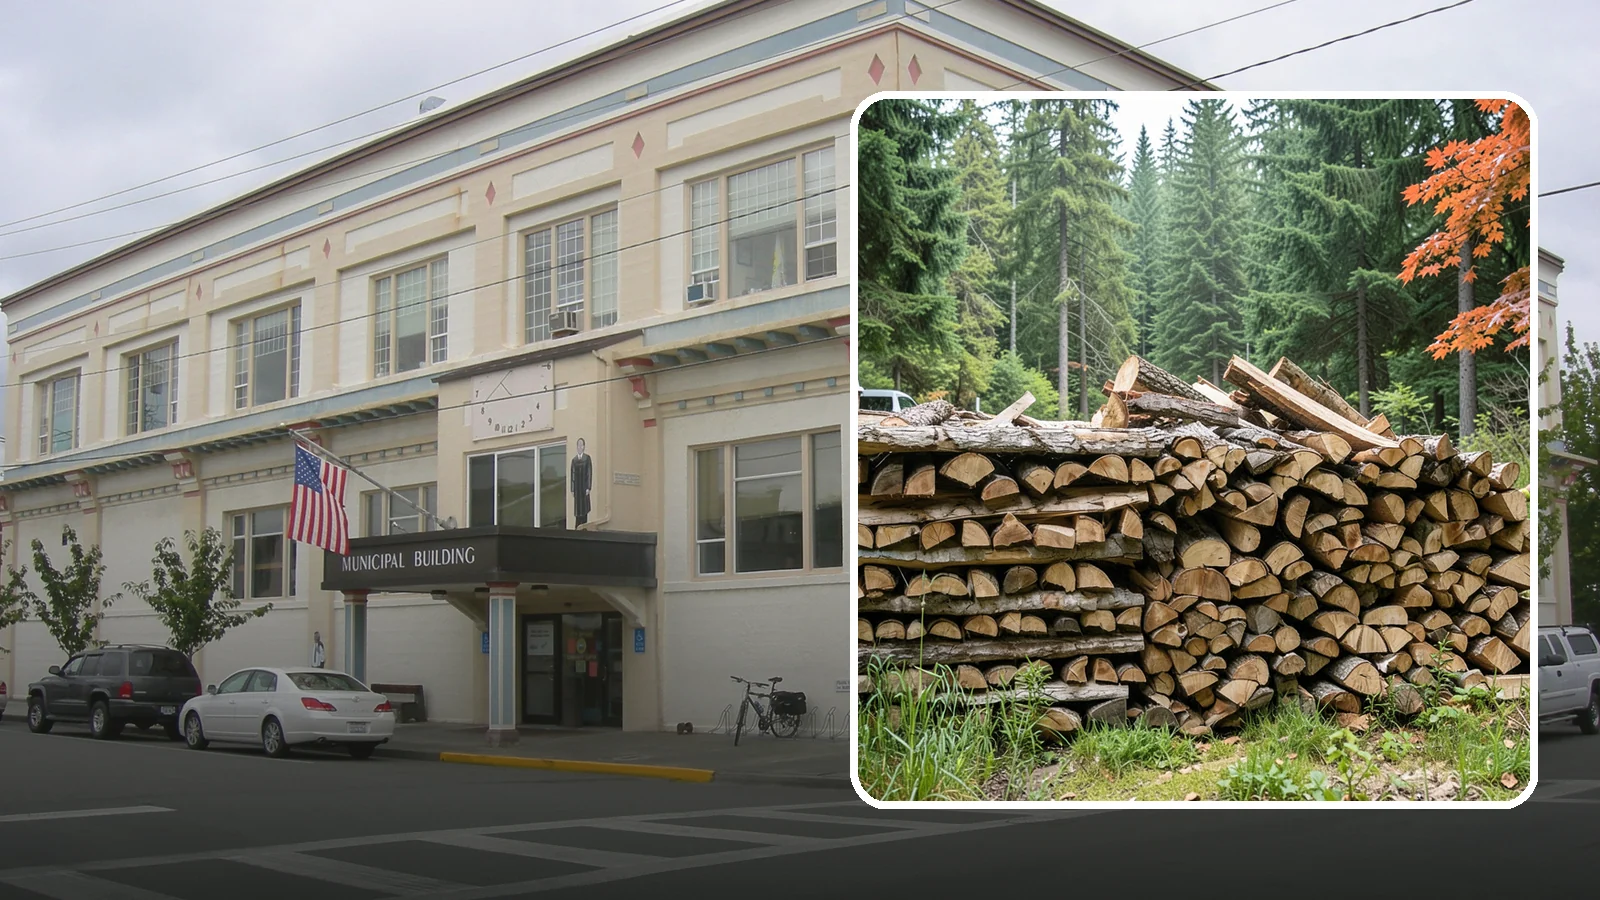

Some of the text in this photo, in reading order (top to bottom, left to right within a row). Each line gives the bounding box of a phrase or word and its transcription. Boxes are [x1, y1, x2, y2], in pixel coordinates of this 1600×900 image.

[476, 390, 479, 398] 7
[481, 407, 485, 415] 8
[488, 418, 492, 426] 9
[529, 414, 533, 422] 3
[494, 424, 500, 432] 10
[342, 546, 475, 572] MUNICIPAL BUILDING
